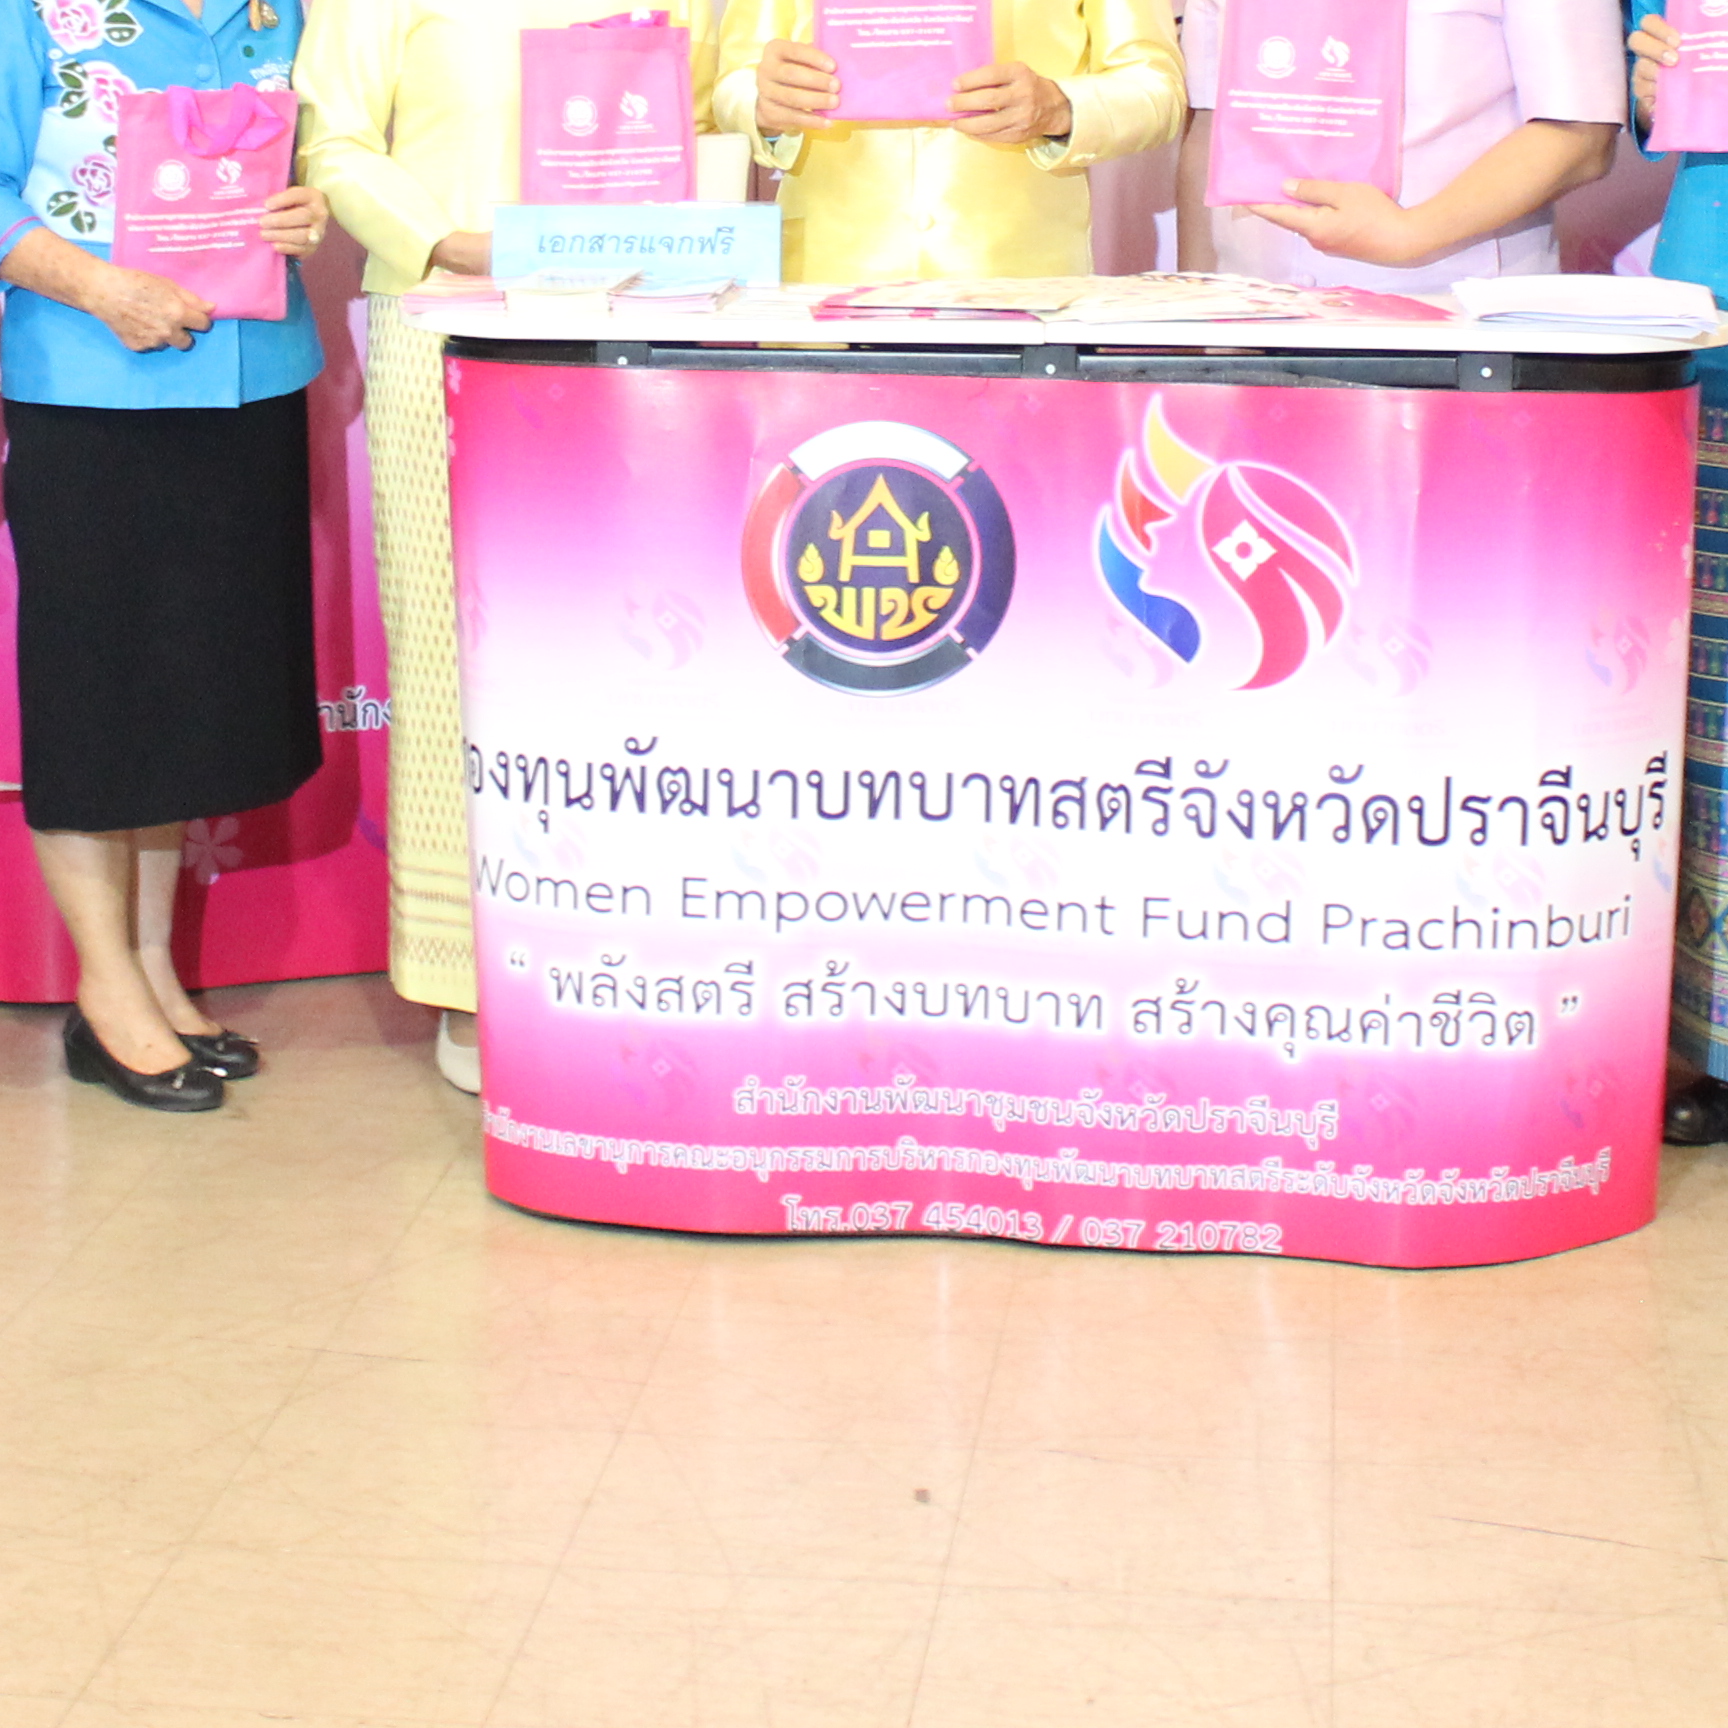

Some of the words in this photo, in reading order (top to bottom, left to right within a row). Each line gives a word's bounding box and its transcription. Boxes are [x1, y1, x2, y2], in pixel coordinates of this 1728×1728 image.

[537, 225, 736, 257] เอกสารแจกฟรี
[475, 853, 651, 917] Women
[679, 875, 1115, 935] Empowerment
[1140, 896, 1292, 944] Fund
[1322, 895, 1631, 951] Prachinburi
[548, 953, 756, 1017] พลังสตรี
[782, 959, 1104, 1031] สร้างบทบาท
[1132, 977, 1537, 1058] สร้างคุณค่าชีวิต
[733, 1076, 1340, 1150] สำนักงานพัฒนาชุมชนจังหวัดปราจีนบุรี
[922, 1202, 1043, 1242] 454013
